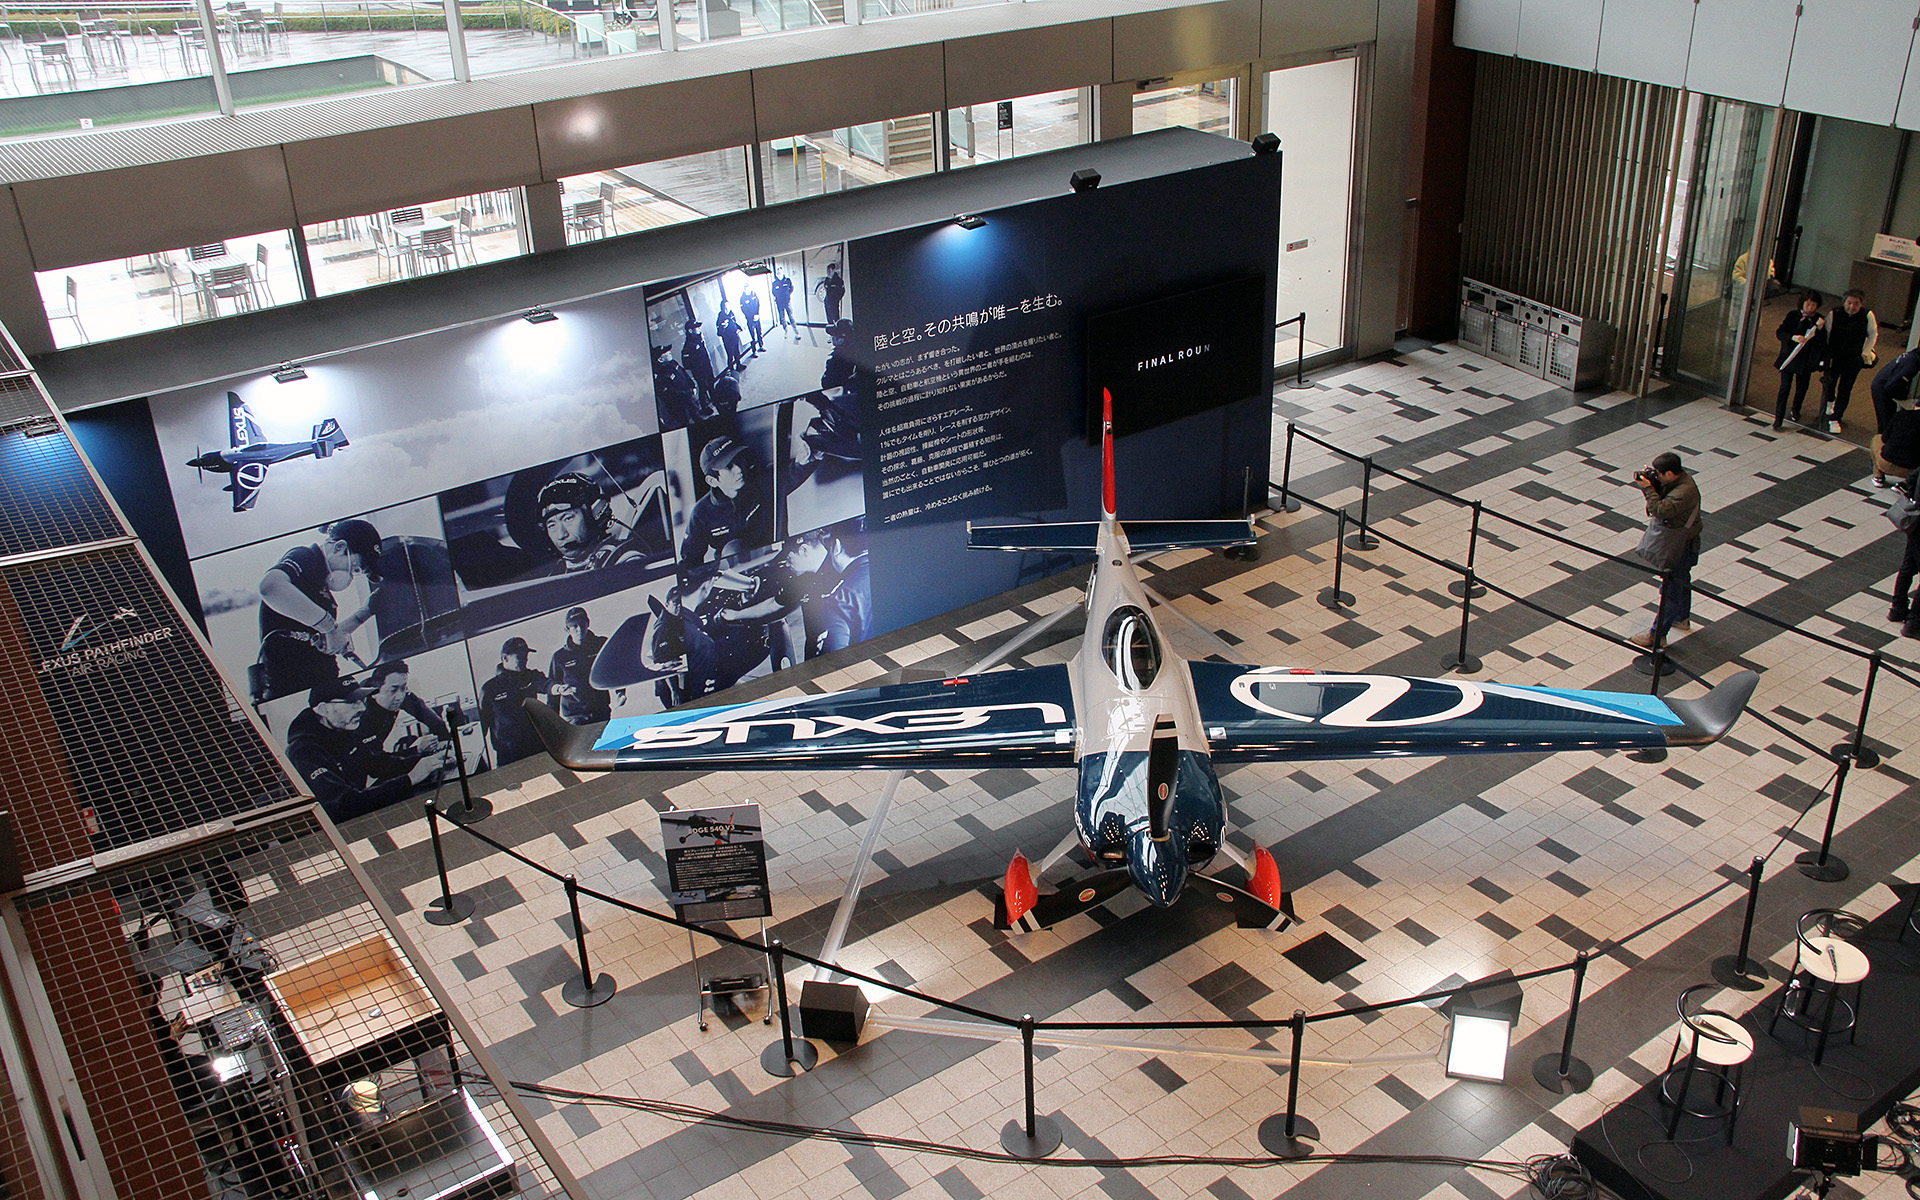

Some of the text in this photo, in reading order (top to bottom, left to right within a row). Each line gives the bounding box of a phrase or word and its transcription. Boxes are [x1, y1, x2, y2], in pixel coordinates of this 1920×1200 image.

[873, 292, 1063, 352] 陸と空。その共鳴が唯一を生む。
[1137, 344, 1210, 371] FINAL ROUN
[232, 406, 250, 450] LEXUS
[71, 648, 147, 677] AIR RACING
[84, 627, 174, 660] PATHFINDER
[633, 702, 1066, 750] LEXUS
